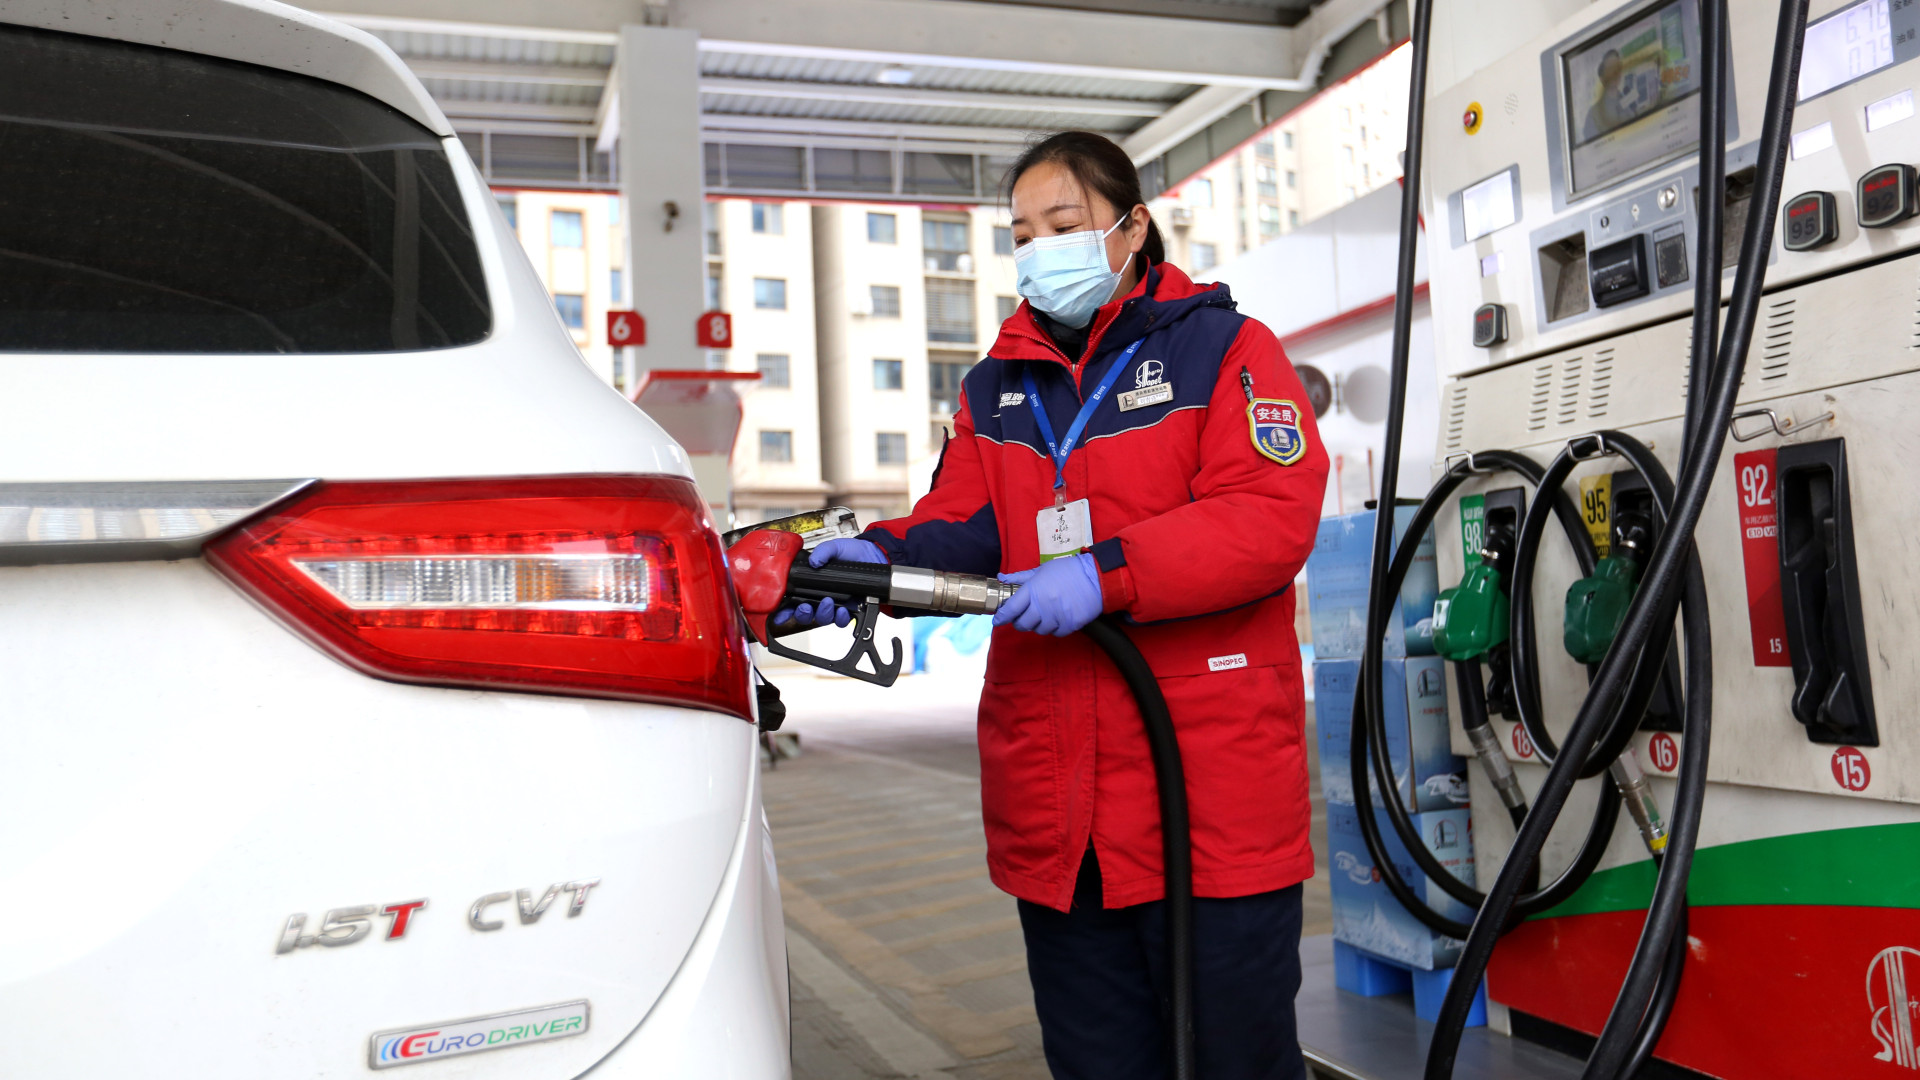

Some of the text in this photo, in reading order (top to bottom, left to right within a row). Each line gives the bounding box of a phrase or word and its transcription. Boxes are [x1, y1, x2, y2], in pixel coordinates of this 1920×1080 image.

[1867, 192, 1894, 214] 92
[1792, 217, 1816, 239] 95
[611, 314, 631, 341] 6
[710, 315, 728, 342] 8
[1257, 408, 1293, 422] 安全员
[1586, 488, 1606, 524] 95
[1464, 521, 1481, 555] 98
[1769, 638, 1782, 653] 15
[1213, 657, 1243, 667] SINOPEC
[1515, 728, 1531, 754] 18
[1655, 738, 1673, 767] 16
[1837, 755, 1865, 787] 15
[468, 876, 600, 932] CVT
